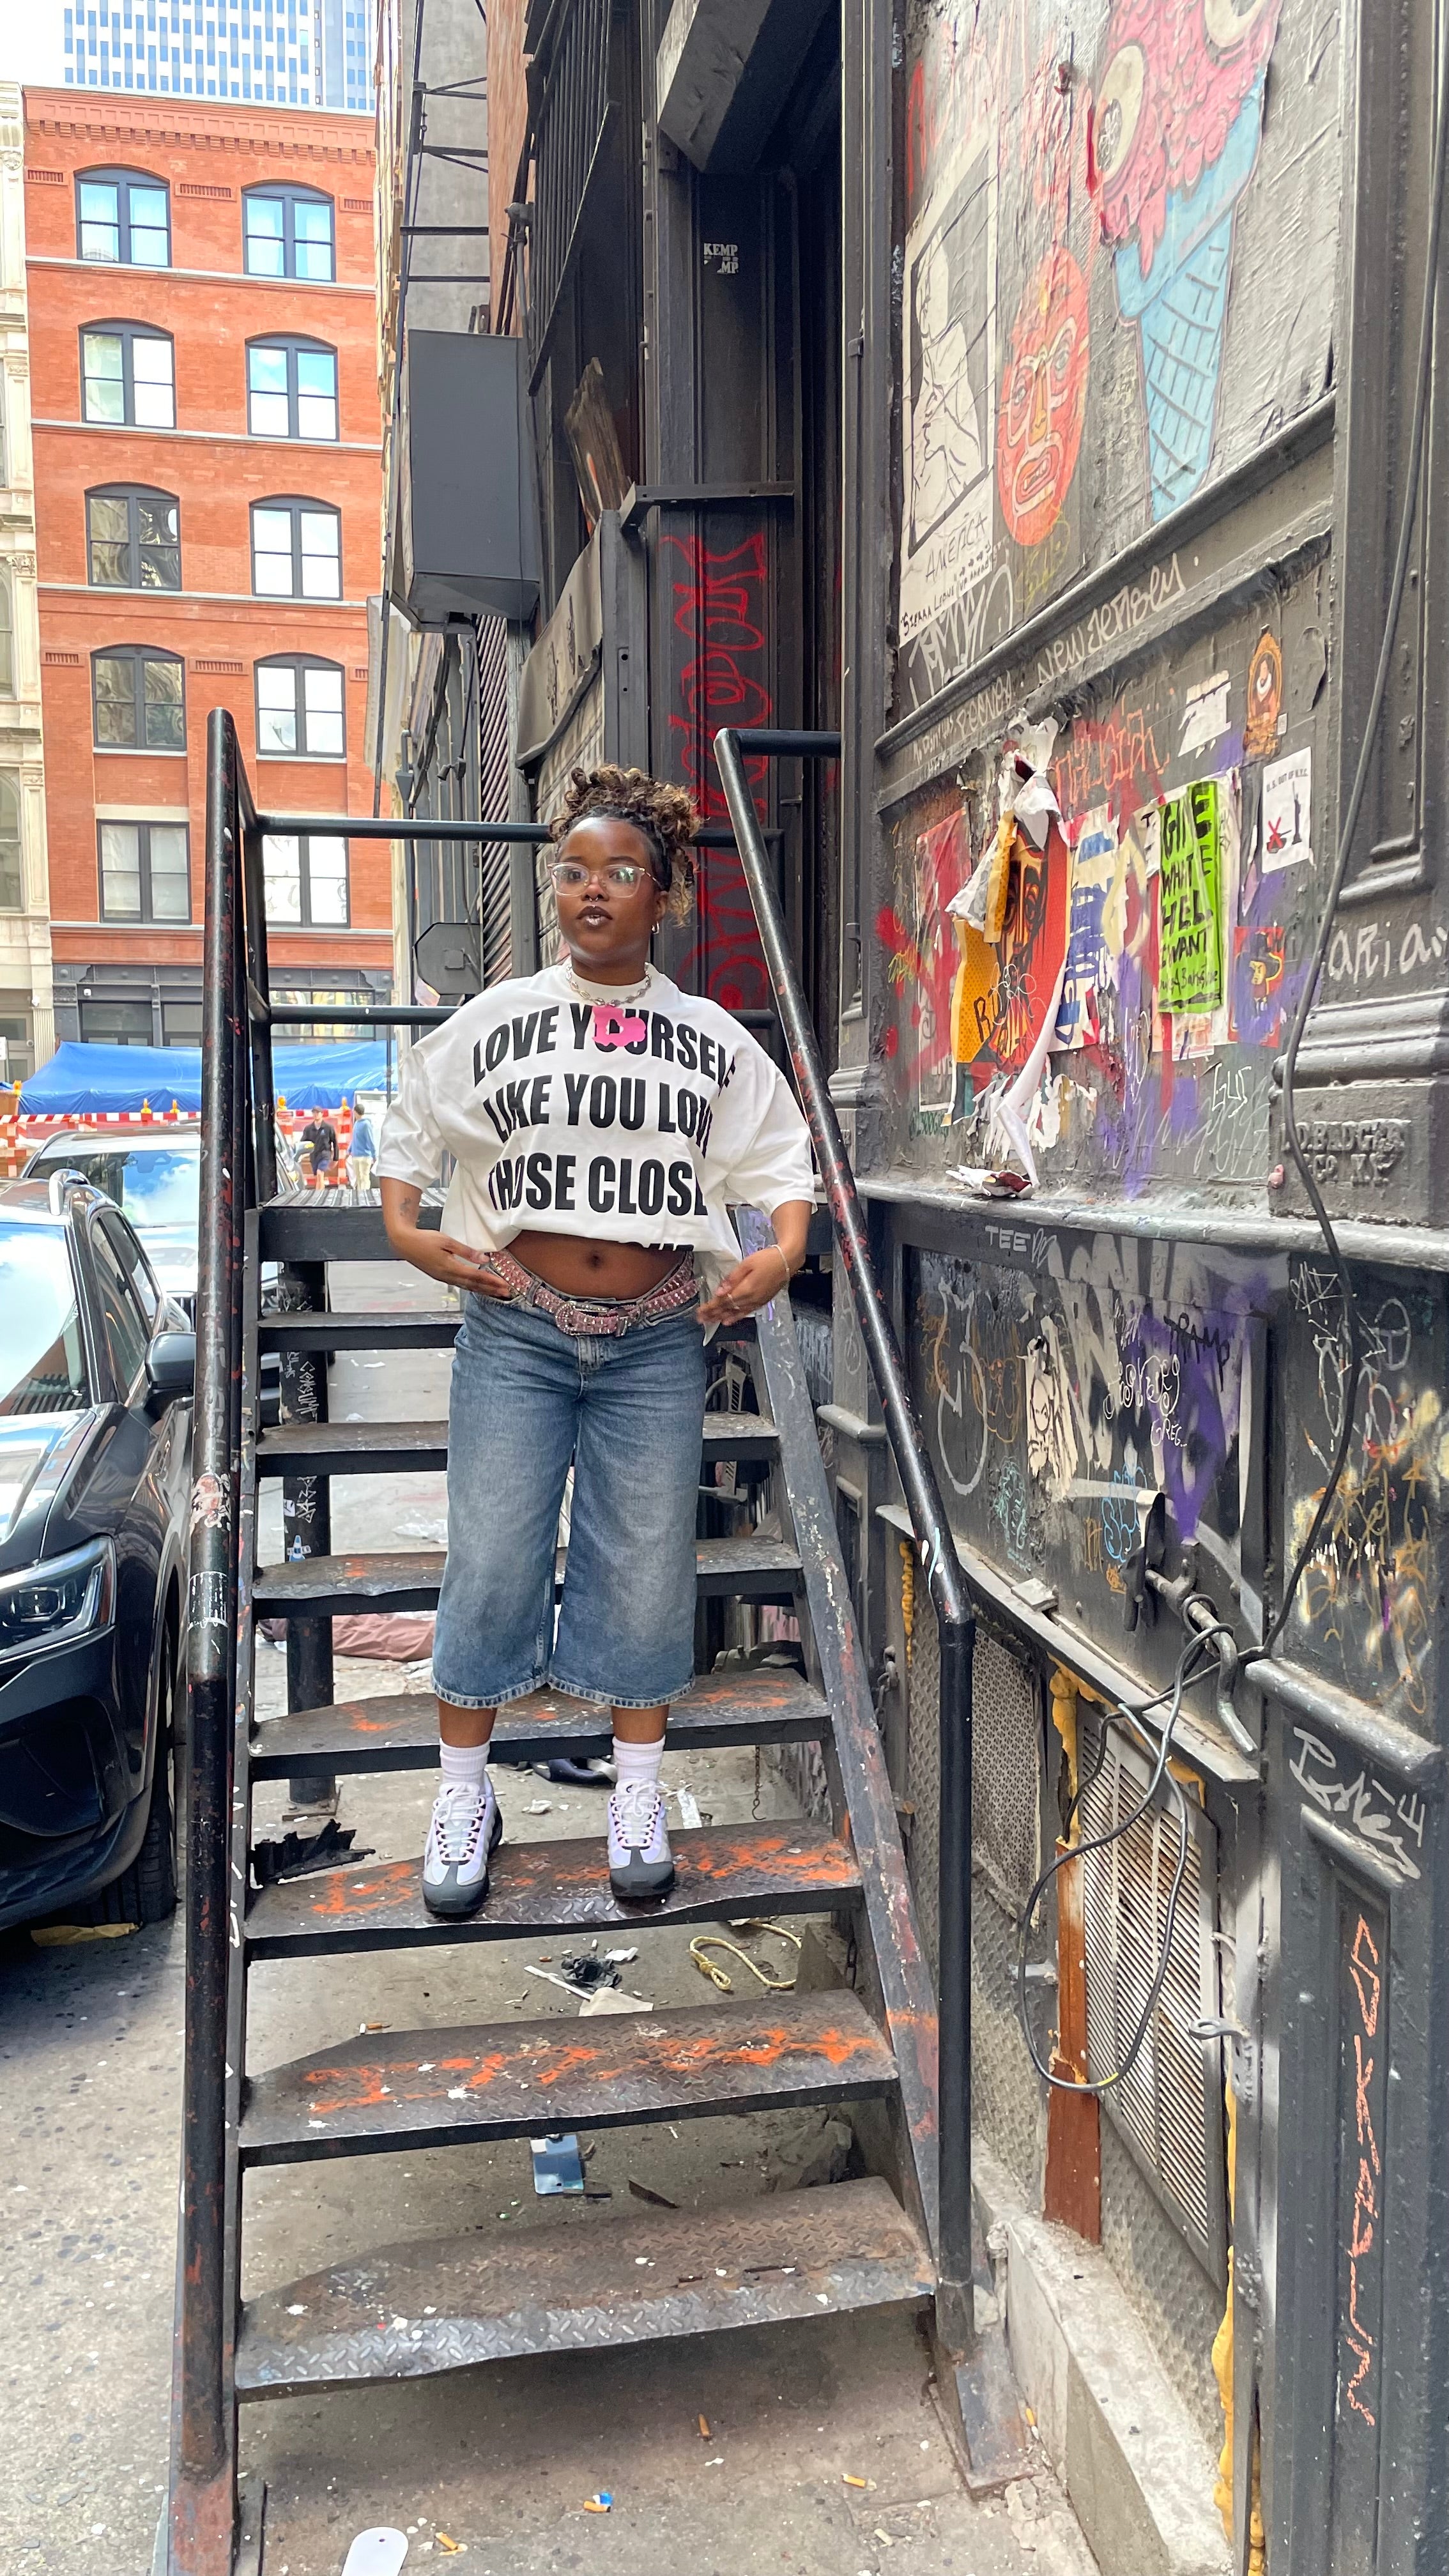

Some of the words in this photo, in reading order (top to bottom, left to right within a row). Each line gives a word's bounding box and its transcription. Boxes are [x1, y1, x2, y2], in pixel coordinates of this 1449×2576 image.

[704, 243, 738, 256] KEMP
[473, 1006, 559, 1087] LOVE
[569, 1002, 735, 1098] YURSEL
[483, 1075, 553, 1143] LIKE
[564, 1073, 646, 1131] YOU
[658, 1082, 713, 1159] LOV
[488, 1152, 576, 1210] HOSE
